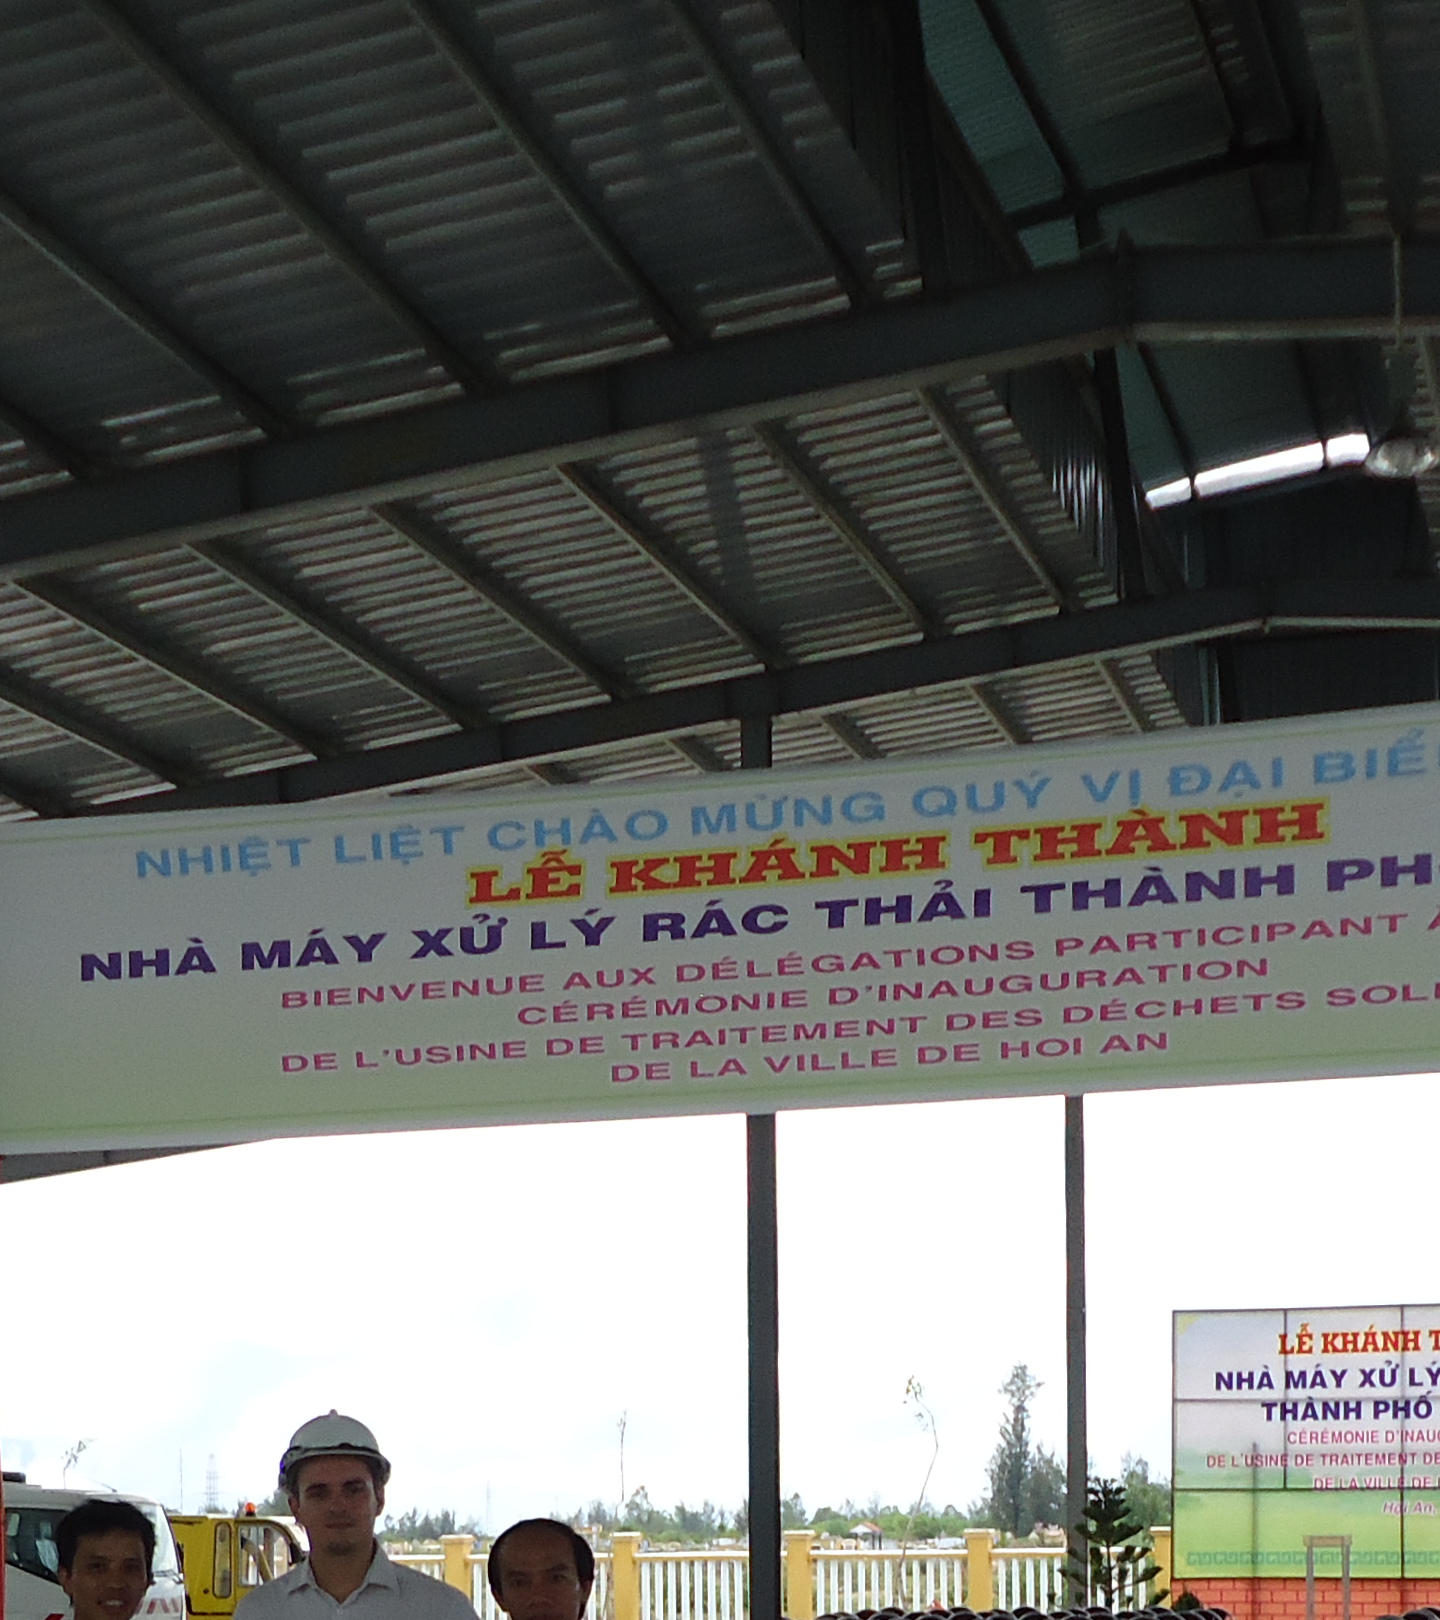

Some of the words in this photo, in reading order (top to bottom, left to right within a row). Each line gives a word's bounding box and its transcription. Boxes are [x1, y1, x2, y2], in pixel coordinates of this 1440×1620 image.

[135, 835, 311, 878] NHIỆT
[334, 823, 465, 866] LIỆT
[486, 808, 669, 851] CHÀO
[690, 790, 886, 836] MỪNG
[911, 769, 1052, 819] QUÝ
[1080, 768, 1142, 806] VỊ
[1168, 757, 1285, 798] ĐẠI
[467, 849, 583, 905] LỄ
[608, 837, 947, 895] KHÁNH
[973, 808, 1325, 866] THÀNH
[79, 936, 217, 982] NHÀ
[240, 928, 388, 971] MÁY
[411, 913, 510, 961] XỬ
[530, 908, 616, 950] LÝ
[642, 900, 790, 942] RÁC
[813, 879, 992, 930] THẢI
[1020, 864, 1296, 914] THÀNH
[281, 974, 545, 1010] BIENVENUE
[563, 967, 656, 992] AUX
[675, 940, 1035, 984] DÉLÉGATIONS
[1055, 914, 1409, 957] PARTICIPANT
[517, 989, 808, 1026] CÉRÉMONIE
[828, 958, 1269, 1006] D'INAUGURATION
[281, 1053, 339, 1073] DE
[355, 1040, 527, 1069] L'USINE
[546, 1036, 605, 1057] DE
[621, 1016, 928, 1051] TRAITEMENT
[945, 1007, 1044, 1033] DES
[1062, 990, 1308, 1025] DÉCHETS
[611, 1063, 671, 1083] DE
[690, 1058, 748, 1078] LA
[764, 1048, 897, 1074] VILLE
[917, 1043, 980, 1065] DE
[1000, 1038, 1082, 1060] HOI
[1099, 1032, 1169, 1054] AN
[1278, 1323, 1314, 1355] LỄ
[1321, 1325, 1421, 1354] KHÁNH
[1215, 1364, 1274, 1391] NHÀ
[1285, 1363, 1348, 1390] MÁY
[1359, 1359, 1400, 1388] XỬ
[1261, 1396, 1362, 1421] THÀNH
[1373, 1390, 1433, 1420] PHỐ
[1207, 1454, 1226, 1468] DE
[1231, 1453, 1288, 1468] L'USINE
[1294, 1453, 1314, 1467] DE
[1320, 1451, 1417, 1467] TRAITEMENT
[1287, 1427, 1379, 1445] CÉRÉMONIE
[1314, 1477, 1334, 1490] DE
[1339, 1477, 1359, 1489] LA
[1364, 1477, 1405, 1490] VILLE
[1411, 1476, 1431, 1489] DE
